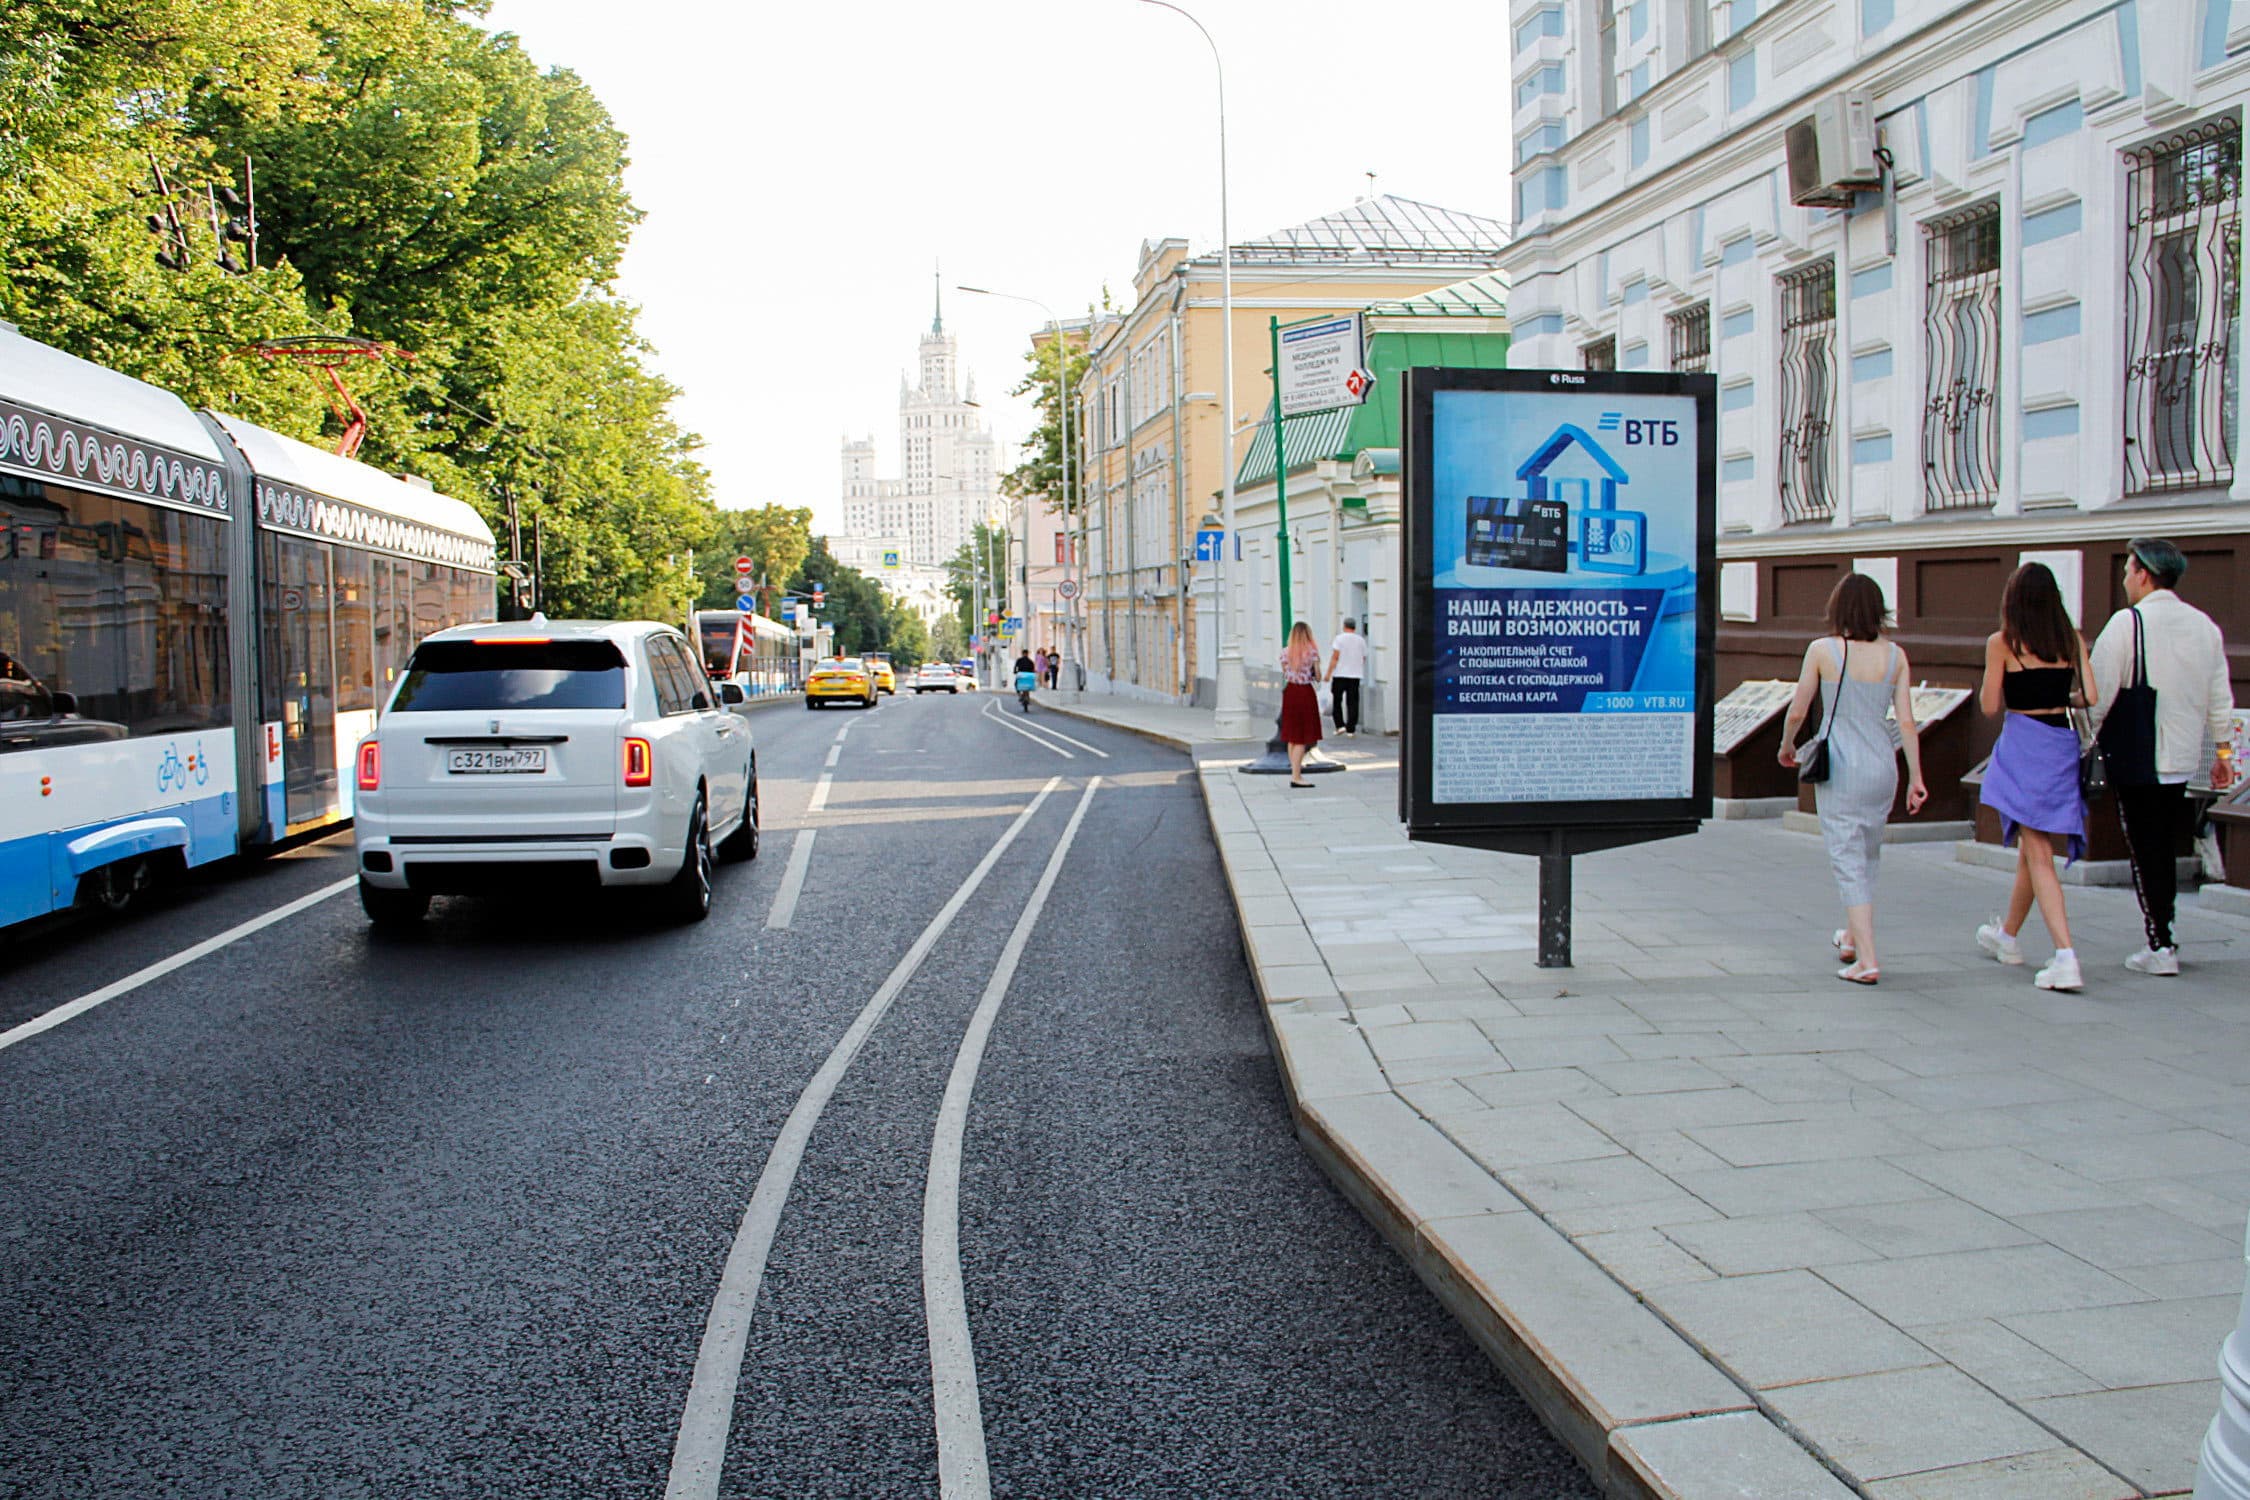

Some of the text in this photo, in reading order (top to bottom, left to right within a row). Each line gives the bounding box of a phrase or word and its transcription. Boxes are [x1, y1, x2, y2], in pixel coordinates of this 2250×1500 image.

[1562, 374, 1586, 384] Russ
[1625, 420, 1679, 446] ВТБ
[1541, 507, 1561, 519] ВТБ
[1448, 600, 1502, 617] НАША
[1508, 600, 1628, 618] НАДЕЖНОСТЬ
[1448, 620, 1640, 636] ВАШИ ВОЗМОЖНОСТИ
[1459, 645, 1573, 656] НАКОПИТЕЛЬНЫЙ СЧЕТ
[1459, 656, 1587, 668] С ПОВЫШЕННОЙ СТАВКОЙ
[1459, 673, 1603, 686] ИПОТЕКА С ГОСПОДДЕРЖКОЙ
[1459, 692, 1558, 703] БЕСПЛАТНАЯ КАРТА
[1606, 697, 1685, 708] 1000 VTB.RU
